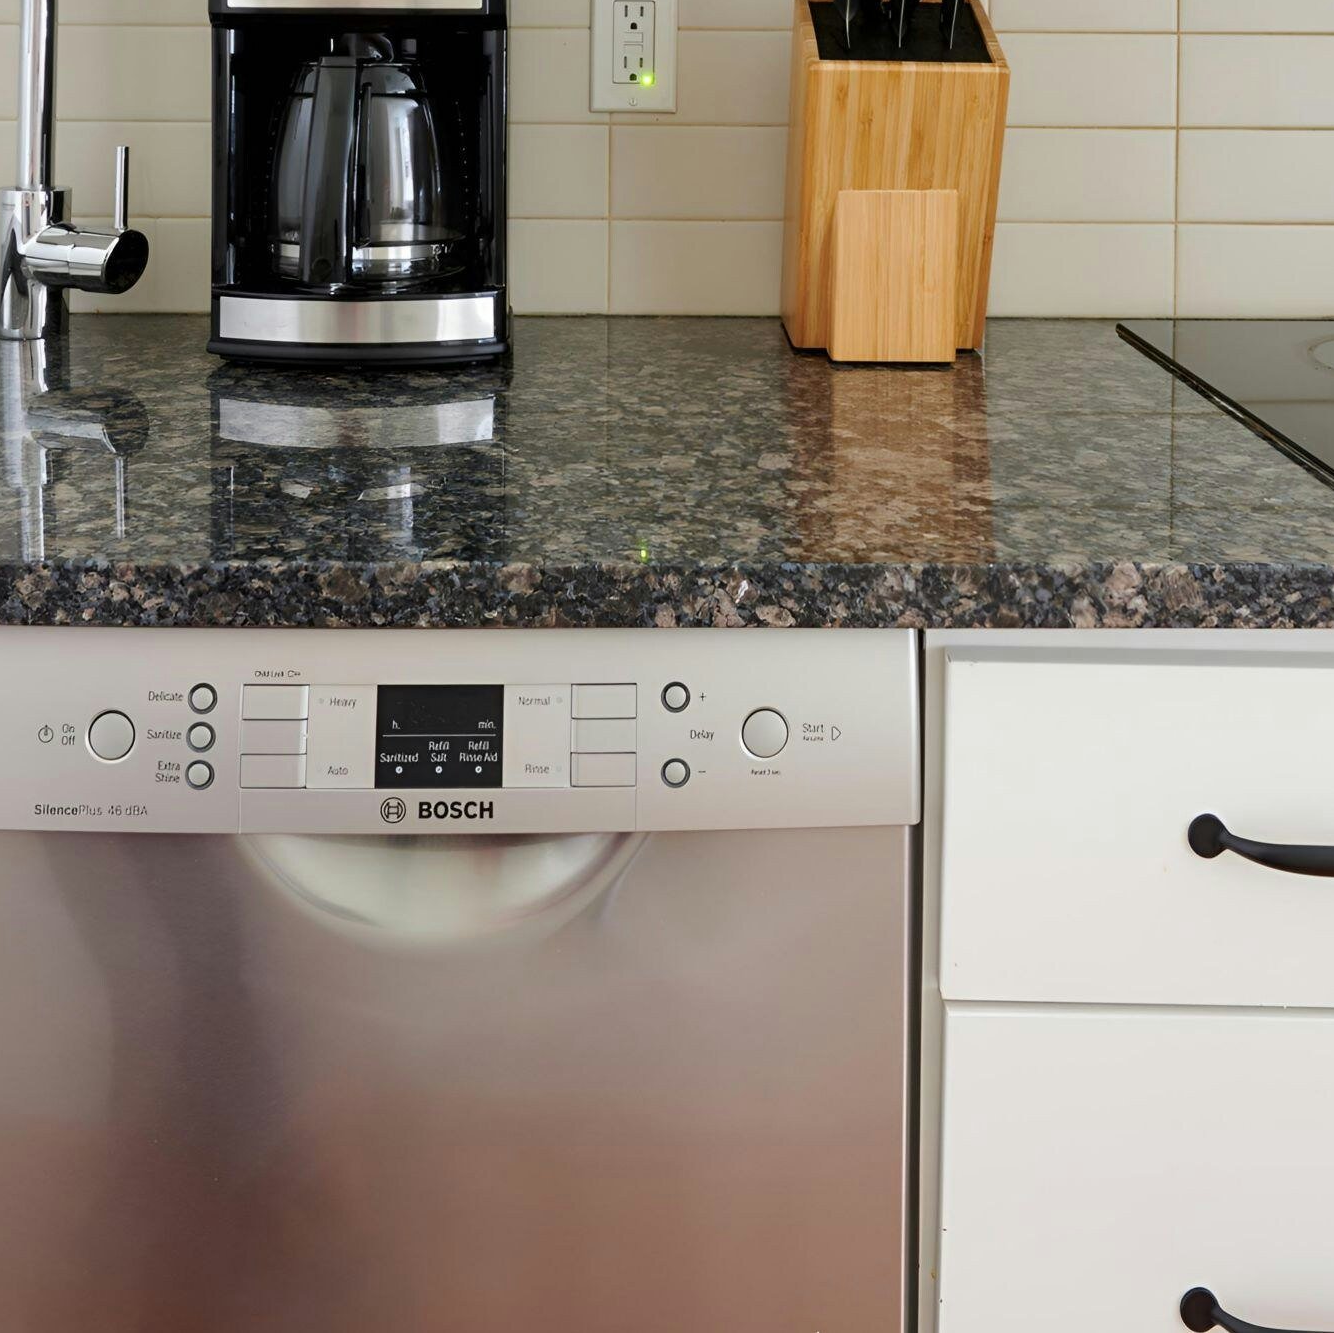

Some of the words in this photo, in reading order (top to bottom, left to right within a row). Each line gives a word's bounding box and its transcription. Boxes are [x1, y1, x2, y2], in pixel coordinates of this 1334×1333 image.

[147, 690, 184, 702] Delicate
[518, 696, 551, 706] Normal
[329, 697, 357, 709] Heavy
[62, 723, 75, 734] On
[802, 722, 824, 734] Start
[61, 735, 76, 746] Off
[147, 729, 182, 741] Sanitize
[690, 729, 715, 741] Delay
[428, 740, 450, 751] Refill
[468, 740, 490, 751] Refill
[379, 752, 419, 764] Sanitized
[430, 752, 447, 763] Salt
[459, 752, 482, 763] Rinse
[158, 760, 181, 772] Extra
[327, 765, 349, 776] Auto
[525, 763, 550, 774] Rinse
[34, 804, 103, 816] SilencePlus
[107, 805, 122, 816] 46
[125, 804, 148, 816] dBA
[418, 800, 495, 819] BOSCH
